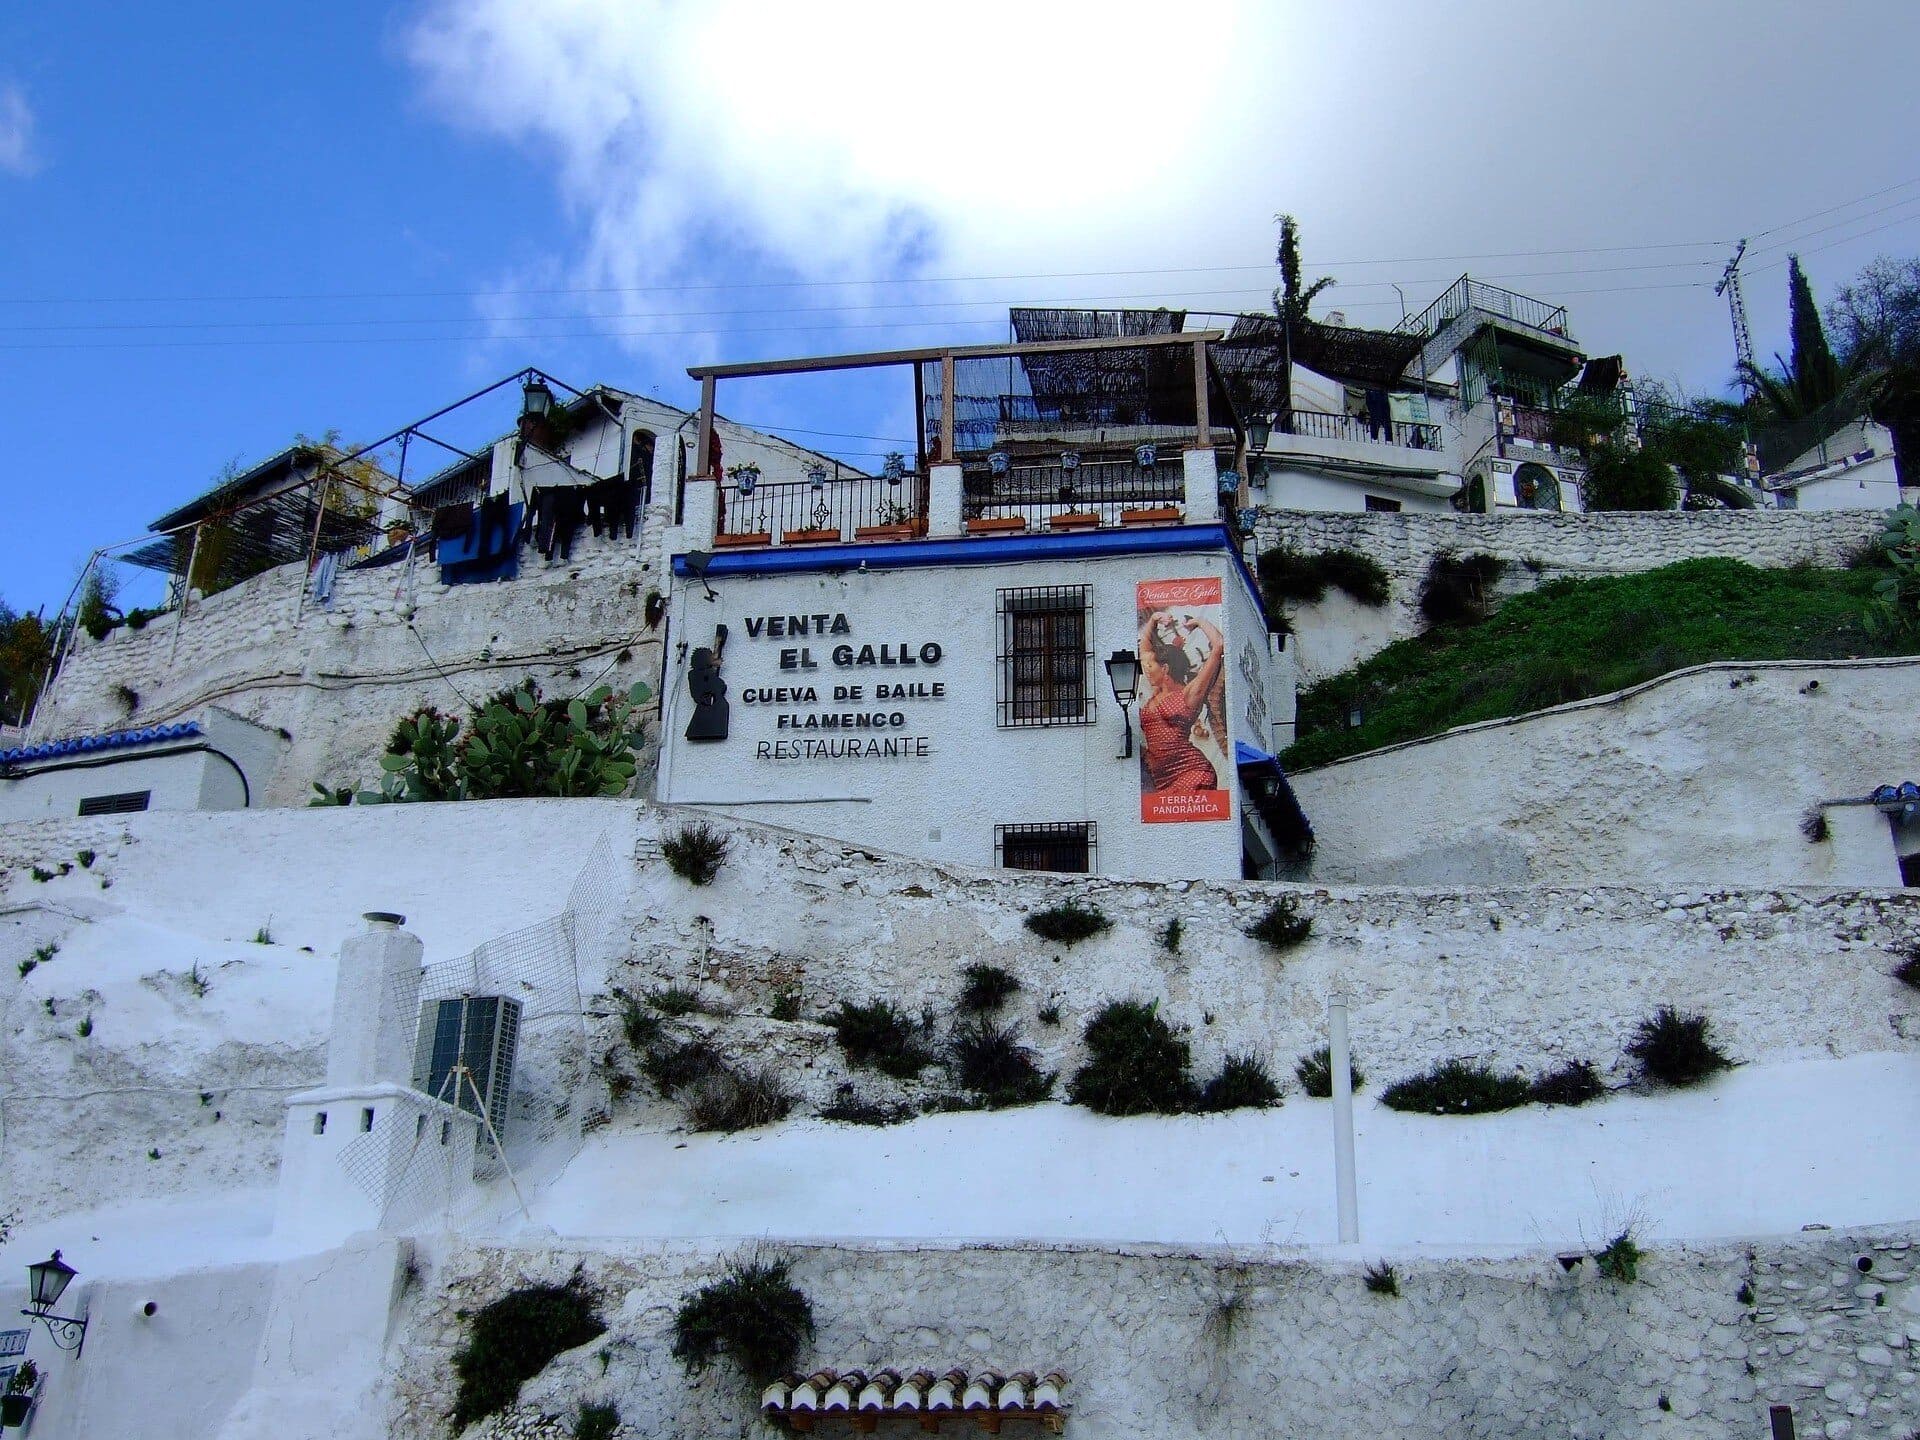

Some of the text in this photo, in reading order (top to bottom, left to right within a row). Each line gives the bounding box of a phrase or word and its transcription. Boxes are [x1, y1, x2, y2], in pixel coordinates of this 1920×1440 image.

[1138, 584, 1219, 600] Venta El Gallo
[744, 613, 850, 638] VENTA
[779, 642, 942, 670] EL GALLO
[742, 682, 946, 704] CUEVA DE BAILE
[777, 712, 905, 729] FLAMENCO
[756, 737, 930, 760] RESTAURANTE
[1153, 802, 1219, 815] PANORÁMICA
[1159, 794, 1208, 805] TERRAZA
